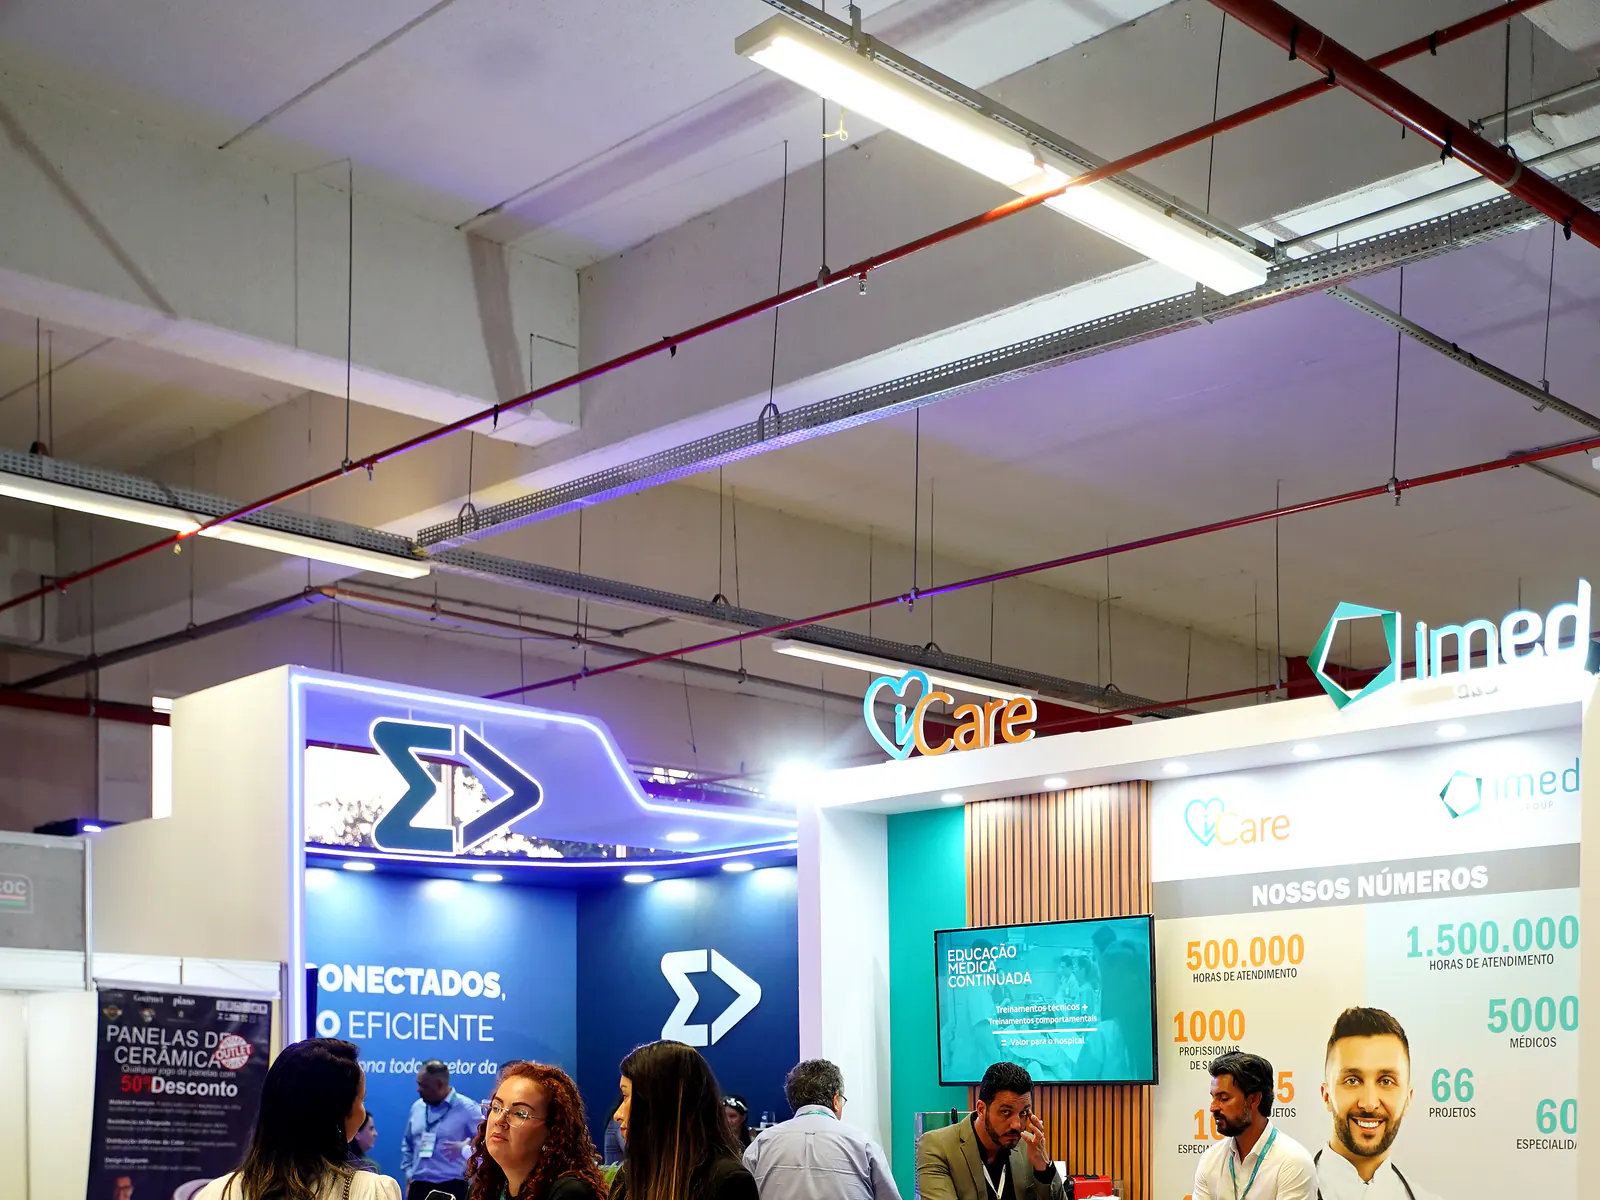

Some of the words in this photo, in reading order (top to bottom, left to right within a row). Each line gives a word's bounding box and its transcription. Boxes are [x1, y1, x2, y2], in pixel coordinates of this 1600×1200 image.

[1414, 578, 1592, 682] imed
[888, 690, 1038, 758] iCare
[1494, 757, 1580, 804] imed
[1519, 800, 1554, 813] ROUP
[0, 880, 27, 895] OC
[1252, 878, 1350, 907] NOSSOS
[1358, 866, 1489, 898] NÚMEROS
[1406, 915, 1579, 959] 1.500.000
[947, 943, 1017, 963] EDUCAÇÃO
[1186, 934, 1305, 971] 500.000
[1429, 958, 1464, 971] HORAS
[1466, 957, 1480, 969] DE
[1481, 953, 1555, 968] ATENDIMENTO
[948, 959, 997, 975] MÉDICA
[1193, 972, 1222, 983] HORAS
[1223, 971, 1235, 982] DE
[1236, 967, 1298, 981] ATENDIMENTO
[305, 962, 506, 1002] ONECTADOS,
[948, 972, 1032, 988] CONTINUADA
[995, 1005, 1047, 1014] Treinamentos
[1047, 1003, 1080, 1012] técnicos
[1487, 995, 1579, 1033] 5000
[350, 1010, 495, 1042] EFICIENTE
[988, 1018, 1034, 1026] Treinamentos
[1035, 1014, 1098, 1025] comportamentais
[1173, 1009, 1246, 1042] 1000
[106, 1025, 199, 1048] PANELAS
[1010, 1038, 1029, 1047] Valor
[1030, 1039, 1047, 1048] para
[1054, 1036, 1085, 1047] hospital
[1509, 1034, 1557, 1048] MÉDICOS
[114, 1044, 222, 1069] CERÂMICA
[215, 1044, 252, 1062] OUTLET
[1179, 1044, 1241, 1056] PROFISSIONAIS
[121, 1064, 157, 1075] Qualquer
[478, 1059, 498, 1074] da
[1189, 1060, 1201, 1070] DE
[151, 1076, 239, 1098] Desconto
[1272, 1071, 1295, 1104] 5
[1431, 1068, 1475, 1102] 66
[1429, 1107, 1477, 1118] PROJETOS
[1536, 1098, 1577, 1134] 60
